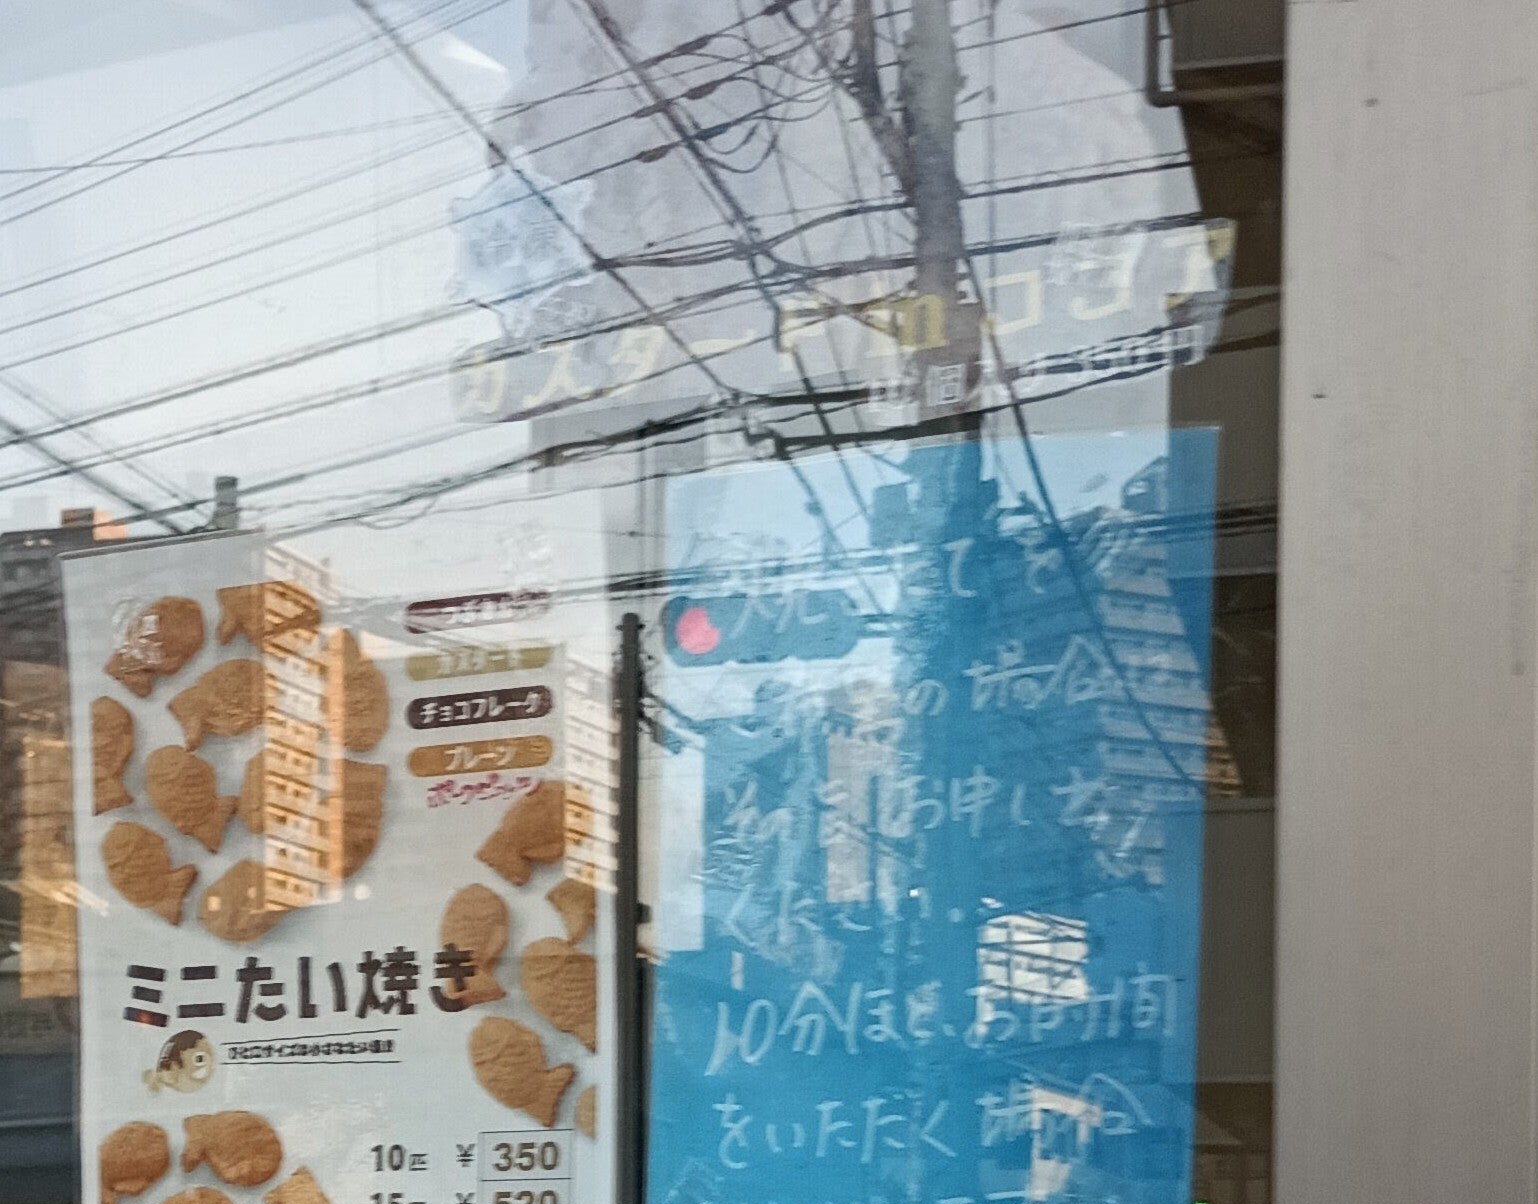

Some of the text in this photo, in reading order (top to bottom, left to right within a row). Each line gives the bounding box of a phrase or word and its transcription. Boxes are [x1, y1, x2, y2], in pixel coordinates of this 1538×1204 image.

[420, 691, 541, 724] チョコフレーク
[123, 943, 478, 1028] ミニたい焼き
[492, 1141, 560, 1172] 350
